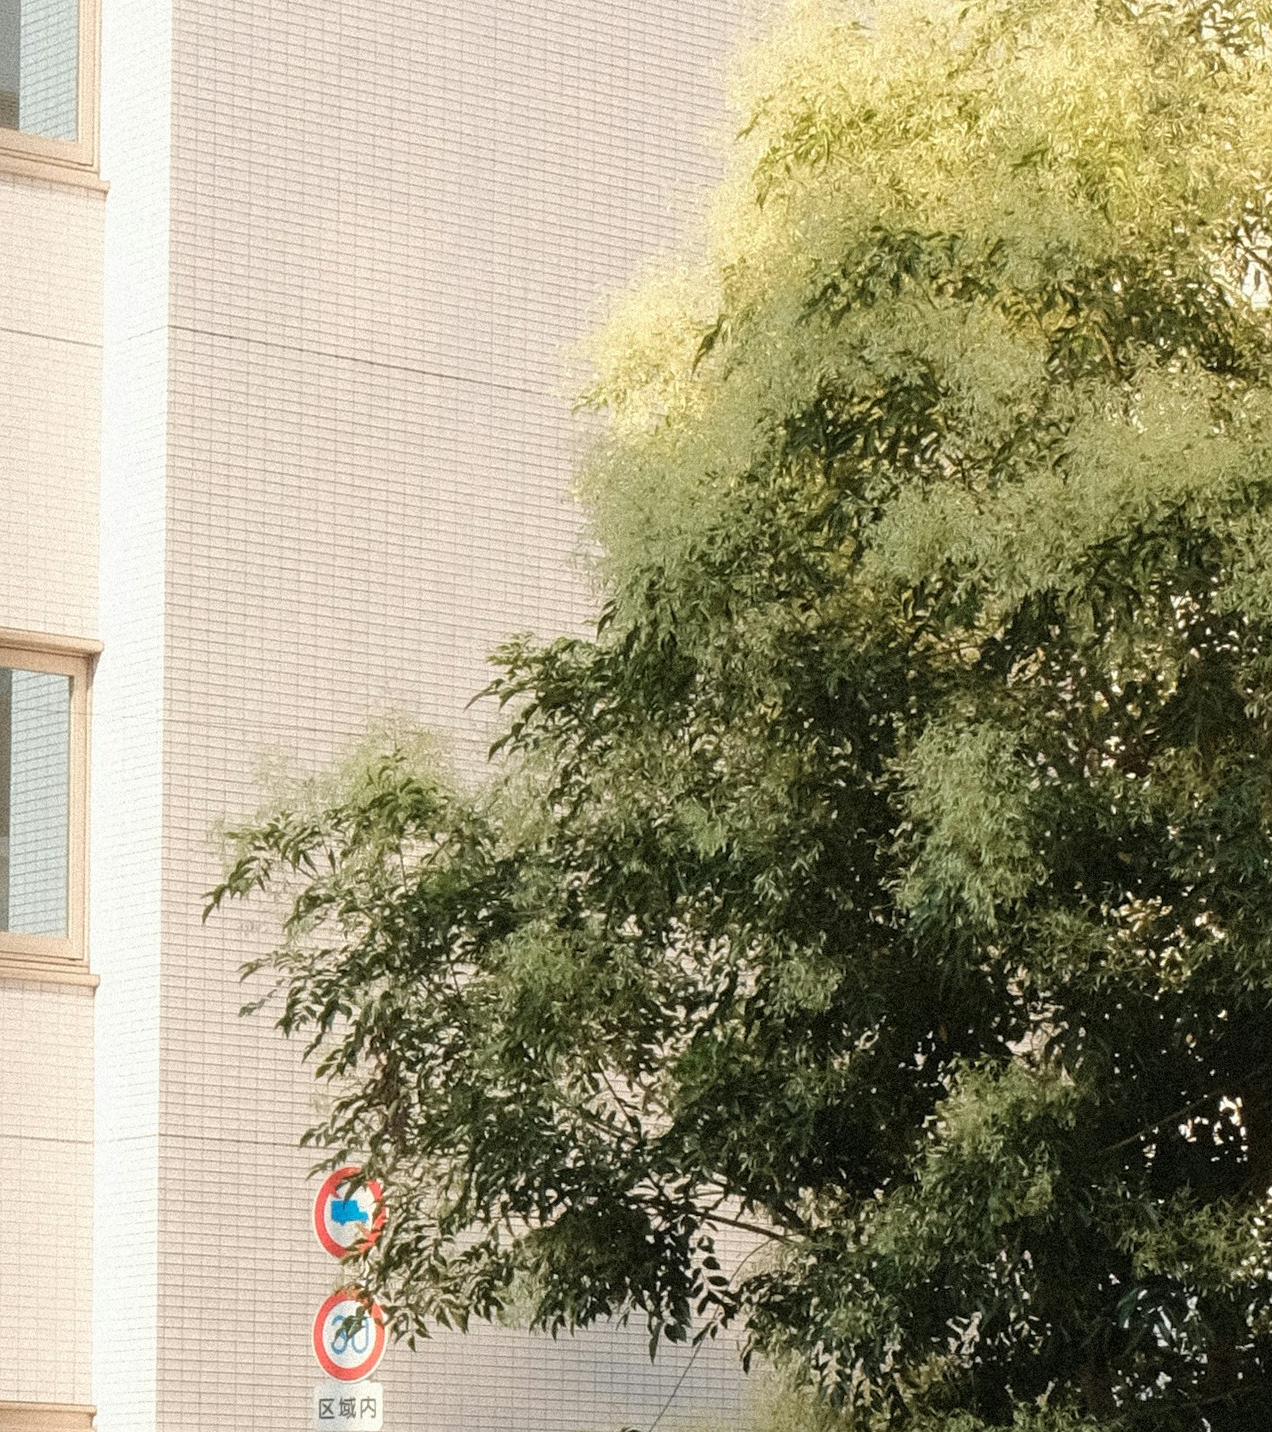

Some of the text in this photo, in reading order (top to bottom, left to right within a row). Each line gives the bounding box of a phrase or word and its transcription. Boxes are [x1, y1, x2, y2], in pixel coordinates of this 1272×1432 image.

[331, 1313, 370, 1356] 30
[318, 1395, 377, 1420] 区域内
